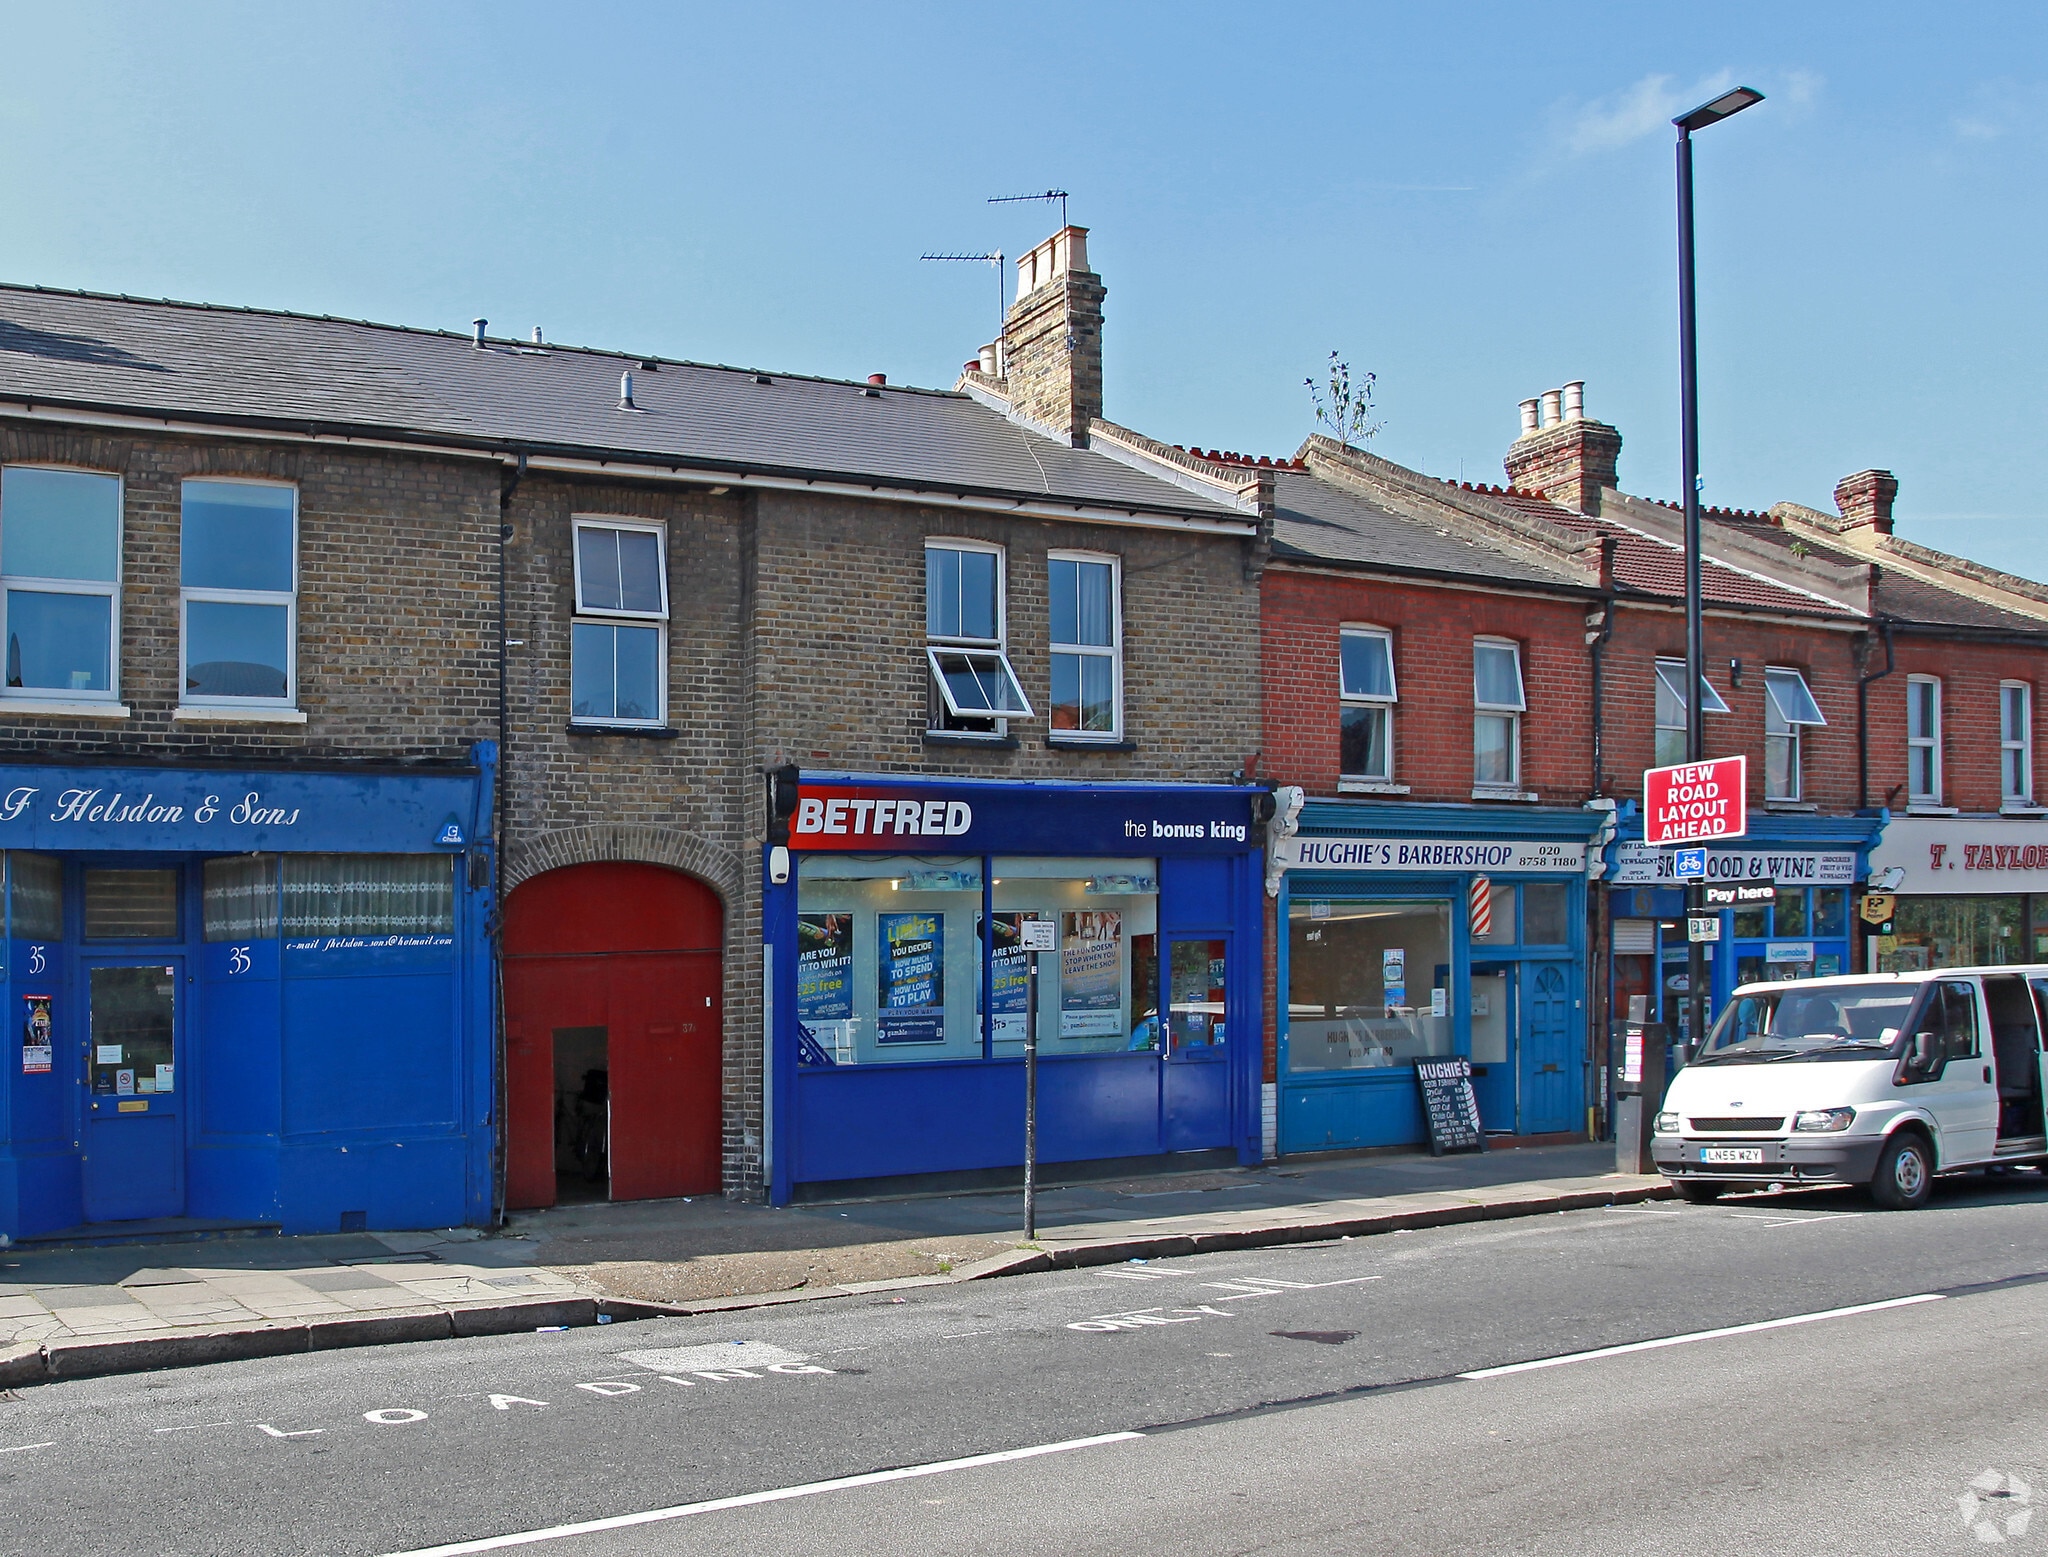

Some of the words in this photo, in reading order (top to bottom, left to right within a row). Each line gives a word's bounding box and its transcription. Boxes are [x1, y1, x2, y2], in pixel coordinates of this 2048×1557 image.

[1671, 765, 1715, 786] NEW
[1667, 782, 1719, 804] ROAD
[50, 788, 185, 823] Helsdon
[194, 794, 221, 824] &
[230, 791, 300, 826] Sons
[1658, 798, 1729, 823] LAYOUT
[796, 798, 972, 836] BETFRED
[1124, 820, 1147, 838] the
[1152, 820, 1205, 838] bonus
[1210, 820, 1246, 842] king
[1661, 817, 1726, 840] AHEAD
[1299, 843, 1392, 865] HUGHIE'S
[1398, 845, 1514, 866] BARBERSHOP
[1538, 846, 1561, 857] 020
[1518, 856, 1548, 867] 8758
[1551, 856, 1578, 868] 1180
[1707, 857, 1743, 877] OOD
[1750, 857, 1763, 877] &
[1767, 857, 1815, 878] WINE
[1707, 889, 1737, 903] Pay
[1737, 886, 1774, 900] here
[286, 938, 320, 950] e-mail
[892, 948, 907, 957] YOU
[908, 941, 932, 953] DECIDE
[992, 947, 1008, 957] ARE
[1063, 949, 1075, 957] THE
[1091, 942, 1118, 952] DOESN'T
[29, 945, 46, 974] 35
[229, 946, 251, 974] 35
[800, 951, 817, 962] ARE
[817, 947, 836, 957] YOU
[895, 959, 910, 968] HOW
[910, 955, 930, 964] MUCH
[1065, 956, 1082, 966] STOP
[1083, 953, 1102, 963] WHEN
[1103, 951, 1116, 959] YOU
[1770, 948, 1808, 958] Lycamobile
[799, 963, 808, 973] IT
[809, 961, 820, 971] TO
[820, 959, 838, 970] WIN
[839, 956, 852, 967] IT?
[891, 968, 903, 979] TO
[905, 962, 933, 976] SPEND
[991, 959, 999, 968] IT
[1000, 957, 1010, 967] TO
[1065, 964, 1084, 975] LEAVE
[1086, 962, 1099, 970] THE
[1100, 959, 1116, 968] SHOP
[819, 979, 842, 991] free
[894, 986, 911, 995] HOW
[912, 981, 930, 990] LONG
[892, 998, 905, 1007] TO
[908, 989, 931, 1003] PLAY
[1417, 1057, 1471, 1080] HUGHIE'S
